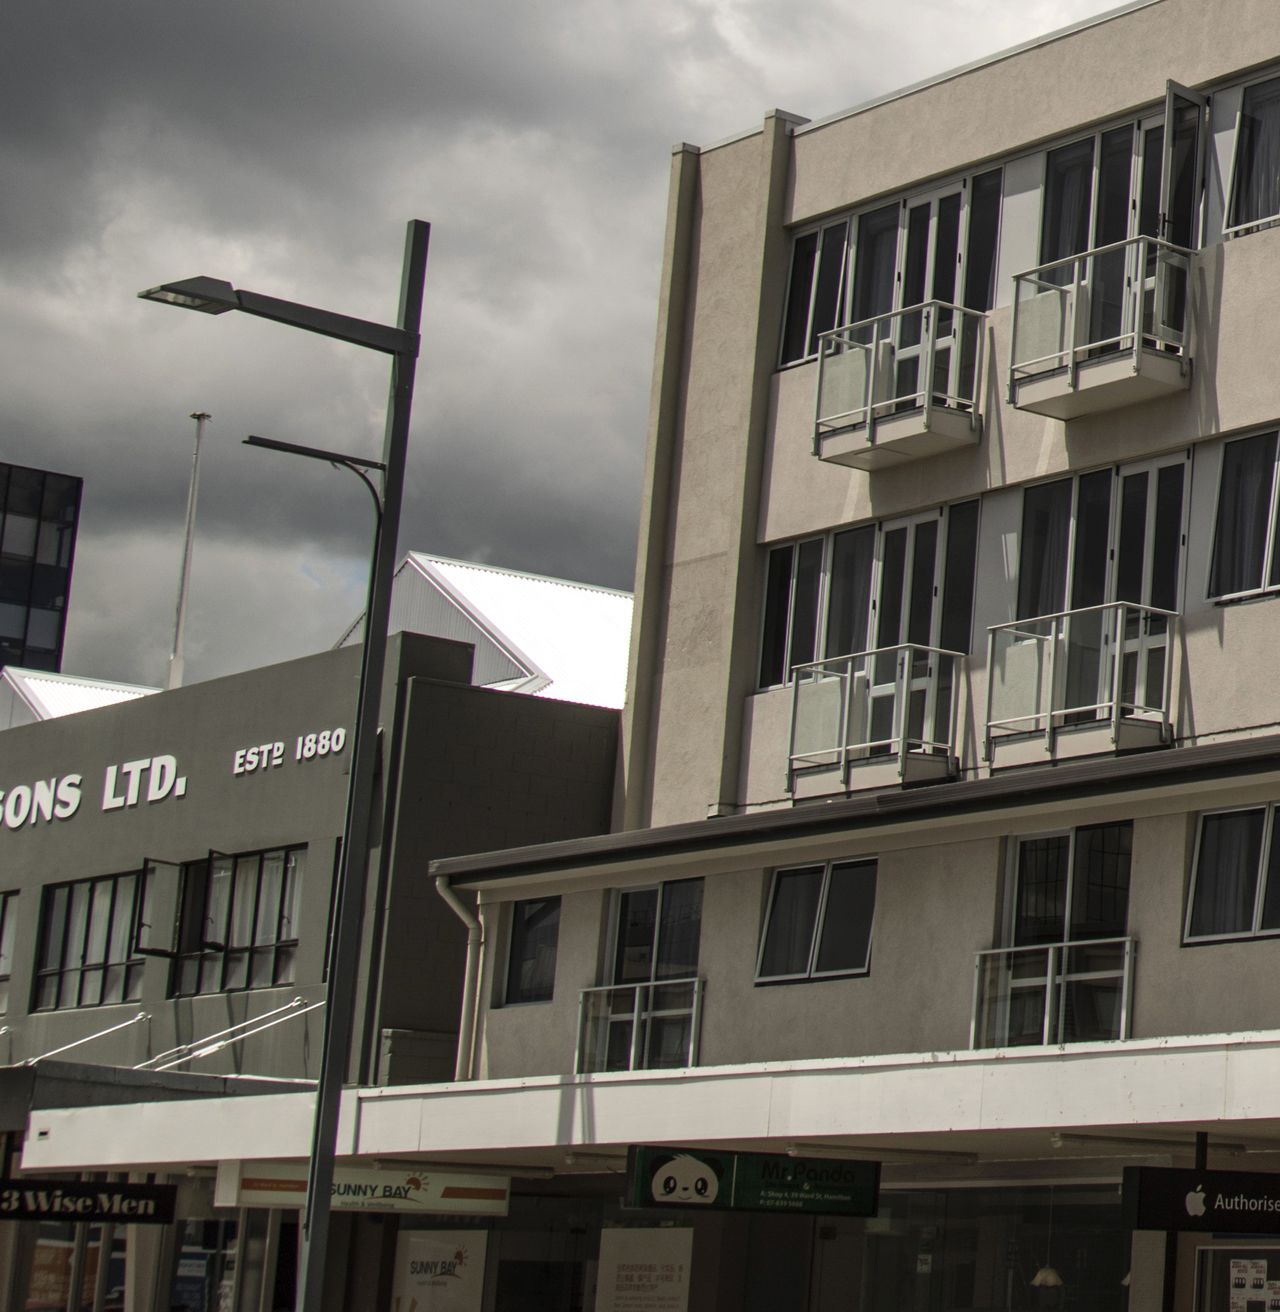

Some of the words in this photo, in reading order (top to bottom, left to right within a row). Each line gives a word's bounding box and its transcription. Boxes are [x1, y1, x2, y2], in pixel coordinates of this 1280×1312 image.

[296, 727, 346, 761] 1880
[0, 774, 83, 829] ONS
[102, 754, 188, 811] LTD.
[0, 1189, 20, 1212] 3
[24, 1189, 93, 1213] Wise
[95, 1193, 155, 1215] Men
[382, 1185, 412, 1199] BAY
[410, 1260, 440, 1275] SUNNY
[440, 1260, 457, 1275] BAY
